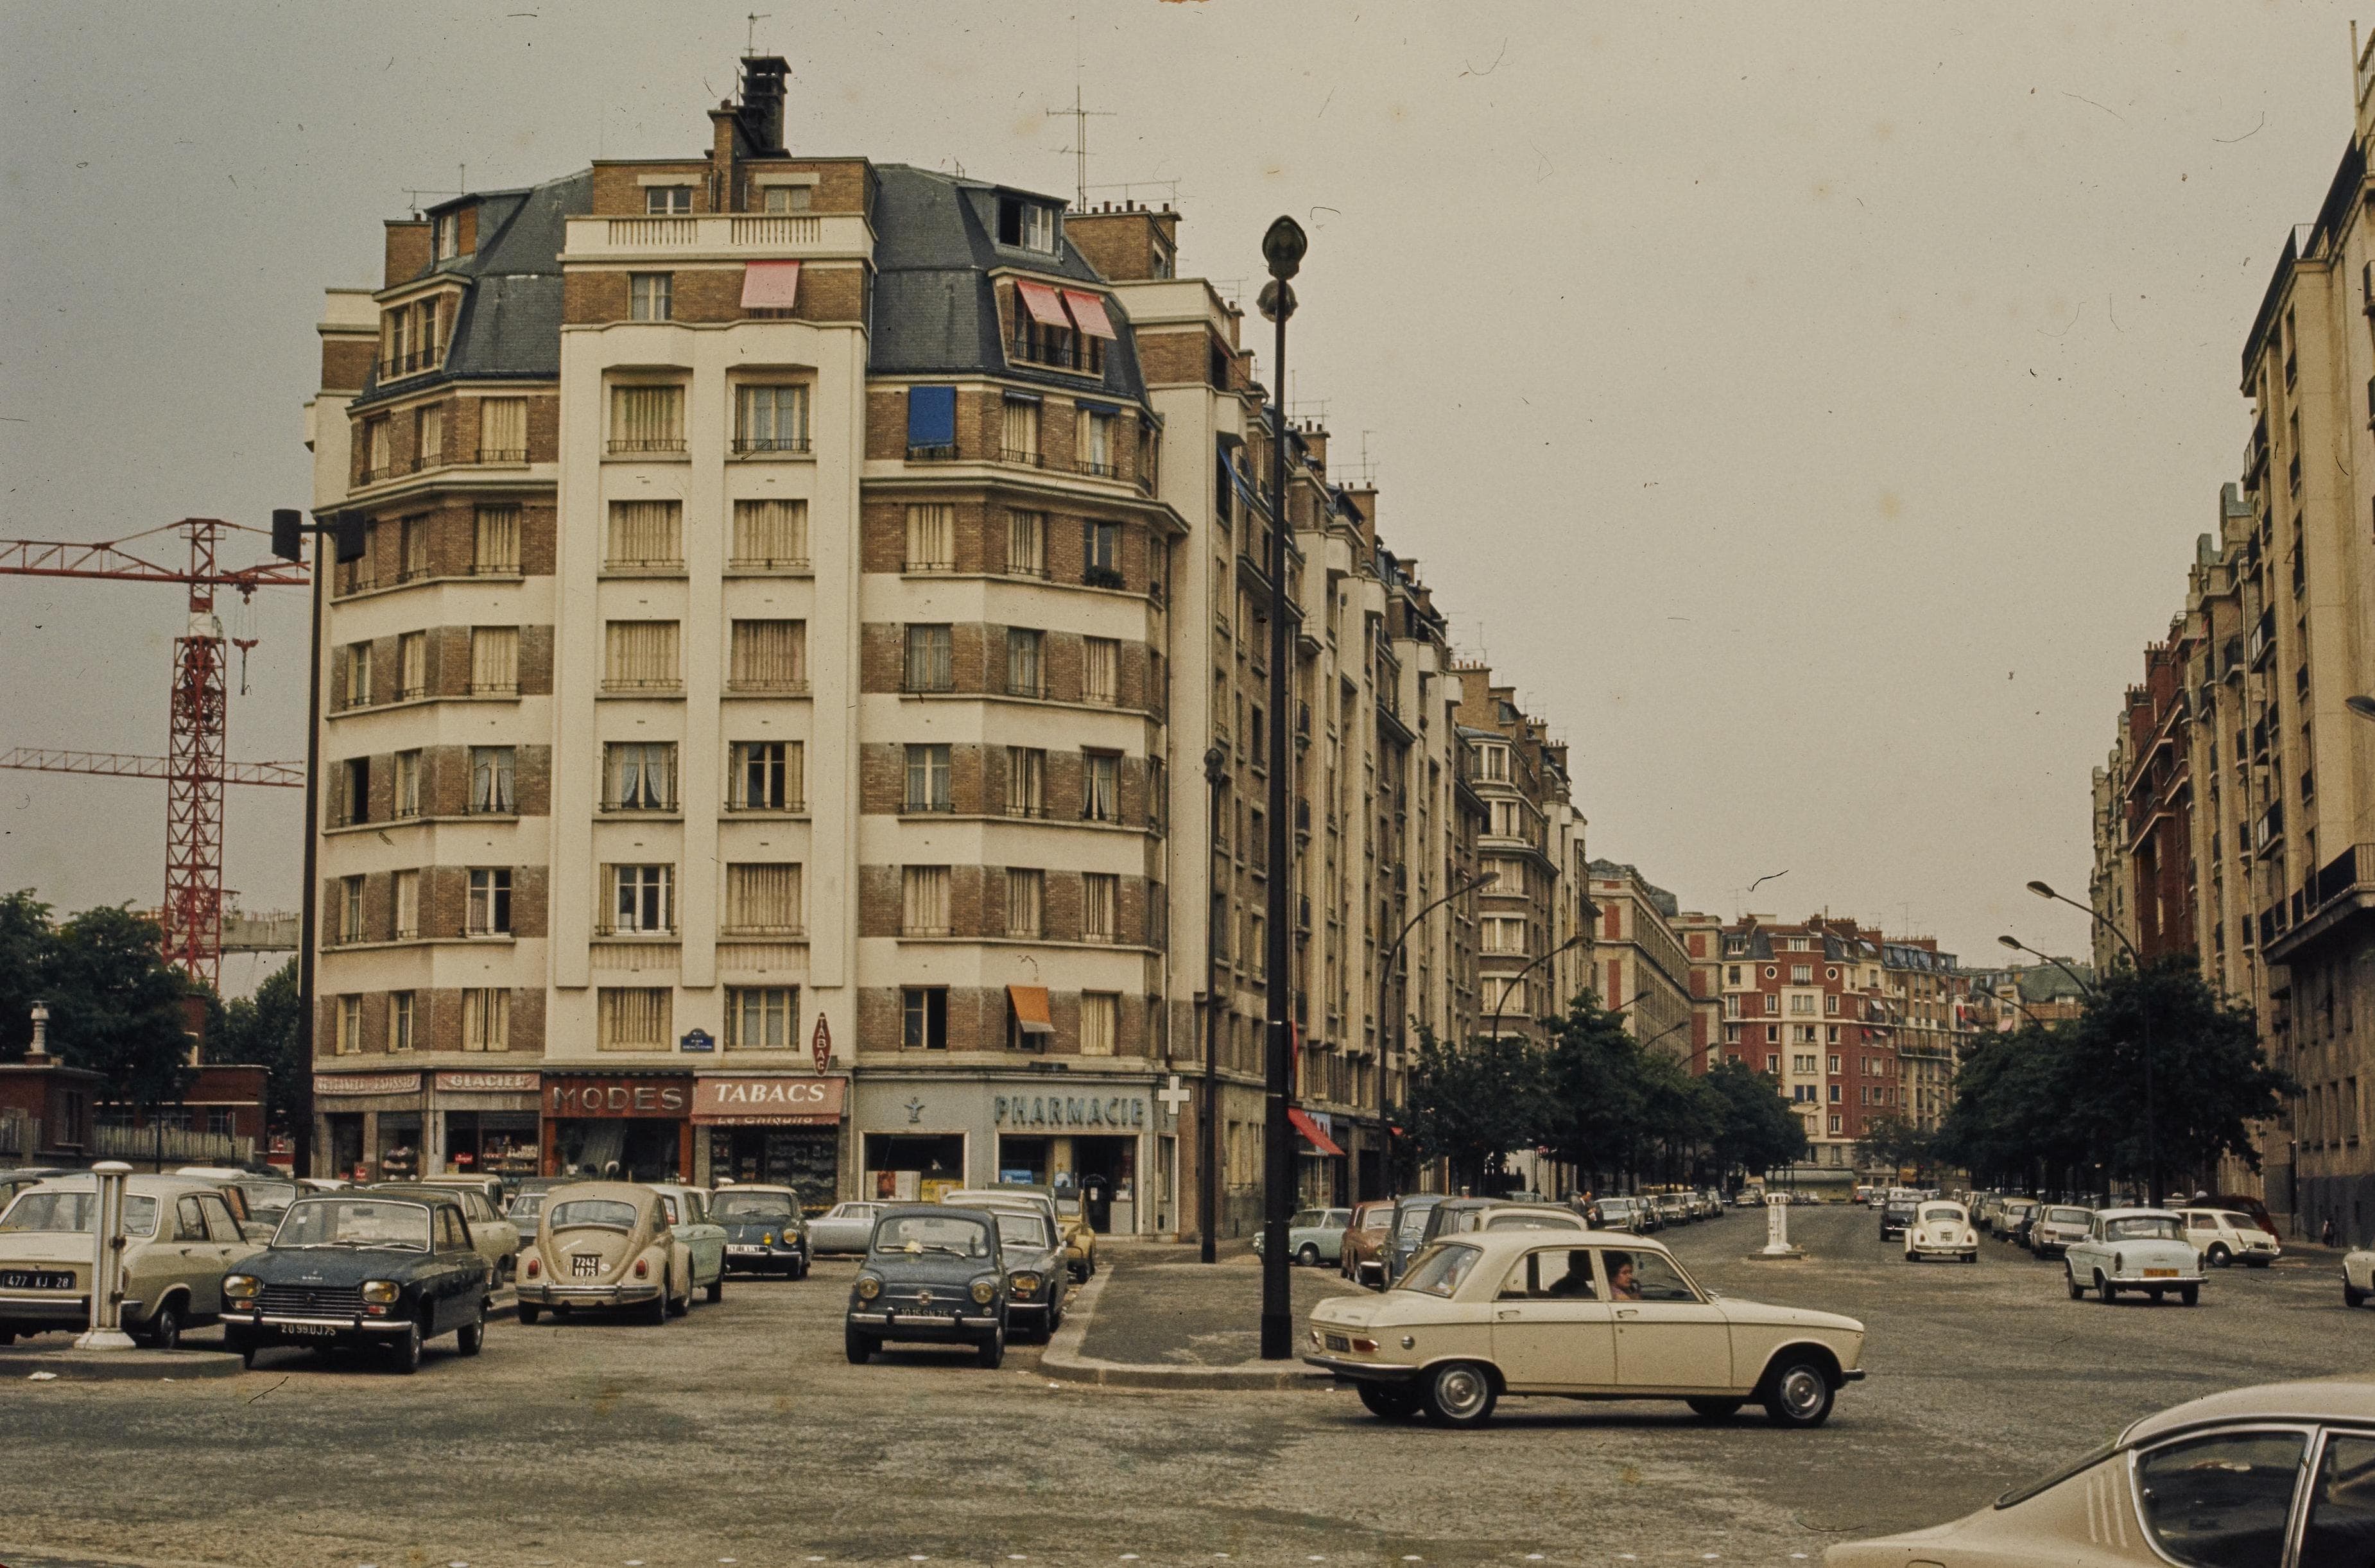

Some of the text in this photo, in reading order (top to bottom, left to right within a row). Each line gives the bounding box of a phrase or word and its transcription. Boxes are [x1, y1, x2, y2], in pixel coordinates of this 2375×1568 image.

[816, 1016, 827, 1071] TABAC
[451, 1075, 525, 1087] GLACIER
[553, 1087, 683, 1110] MODES
[715, 1083, 826, 1103] TABACS
[995, 1096, 1143, 1126] PHARMACIE
